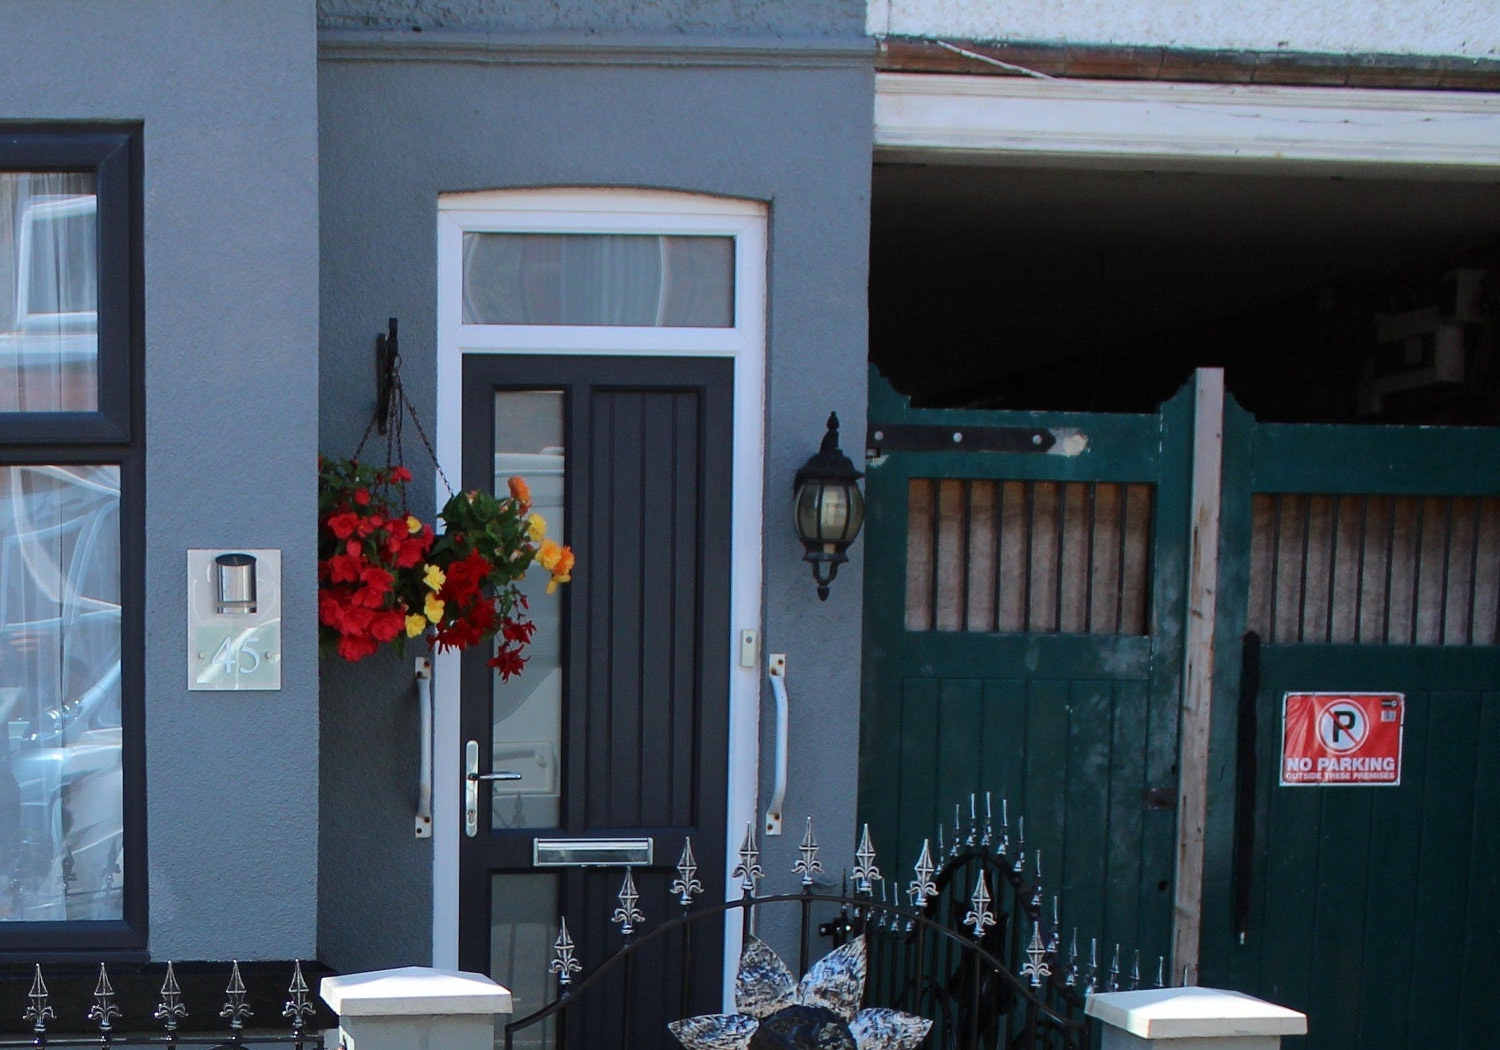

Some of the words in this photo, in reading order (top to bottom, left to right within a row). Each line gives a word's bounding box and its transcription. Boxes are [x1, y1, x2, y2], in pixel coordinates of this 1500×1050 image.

[211, 636, 261, 674] 45
[1332, 710, 1356, 743] P
[1286, 757, 1312, 771] NO
[1317, 757, 1395, 771] PARKING
[1285, 772, 1321, 780] OUTSIDE
[1323, 772, 1351, 780] THESE
[1353, 772, 1395, 780] PREMISES
